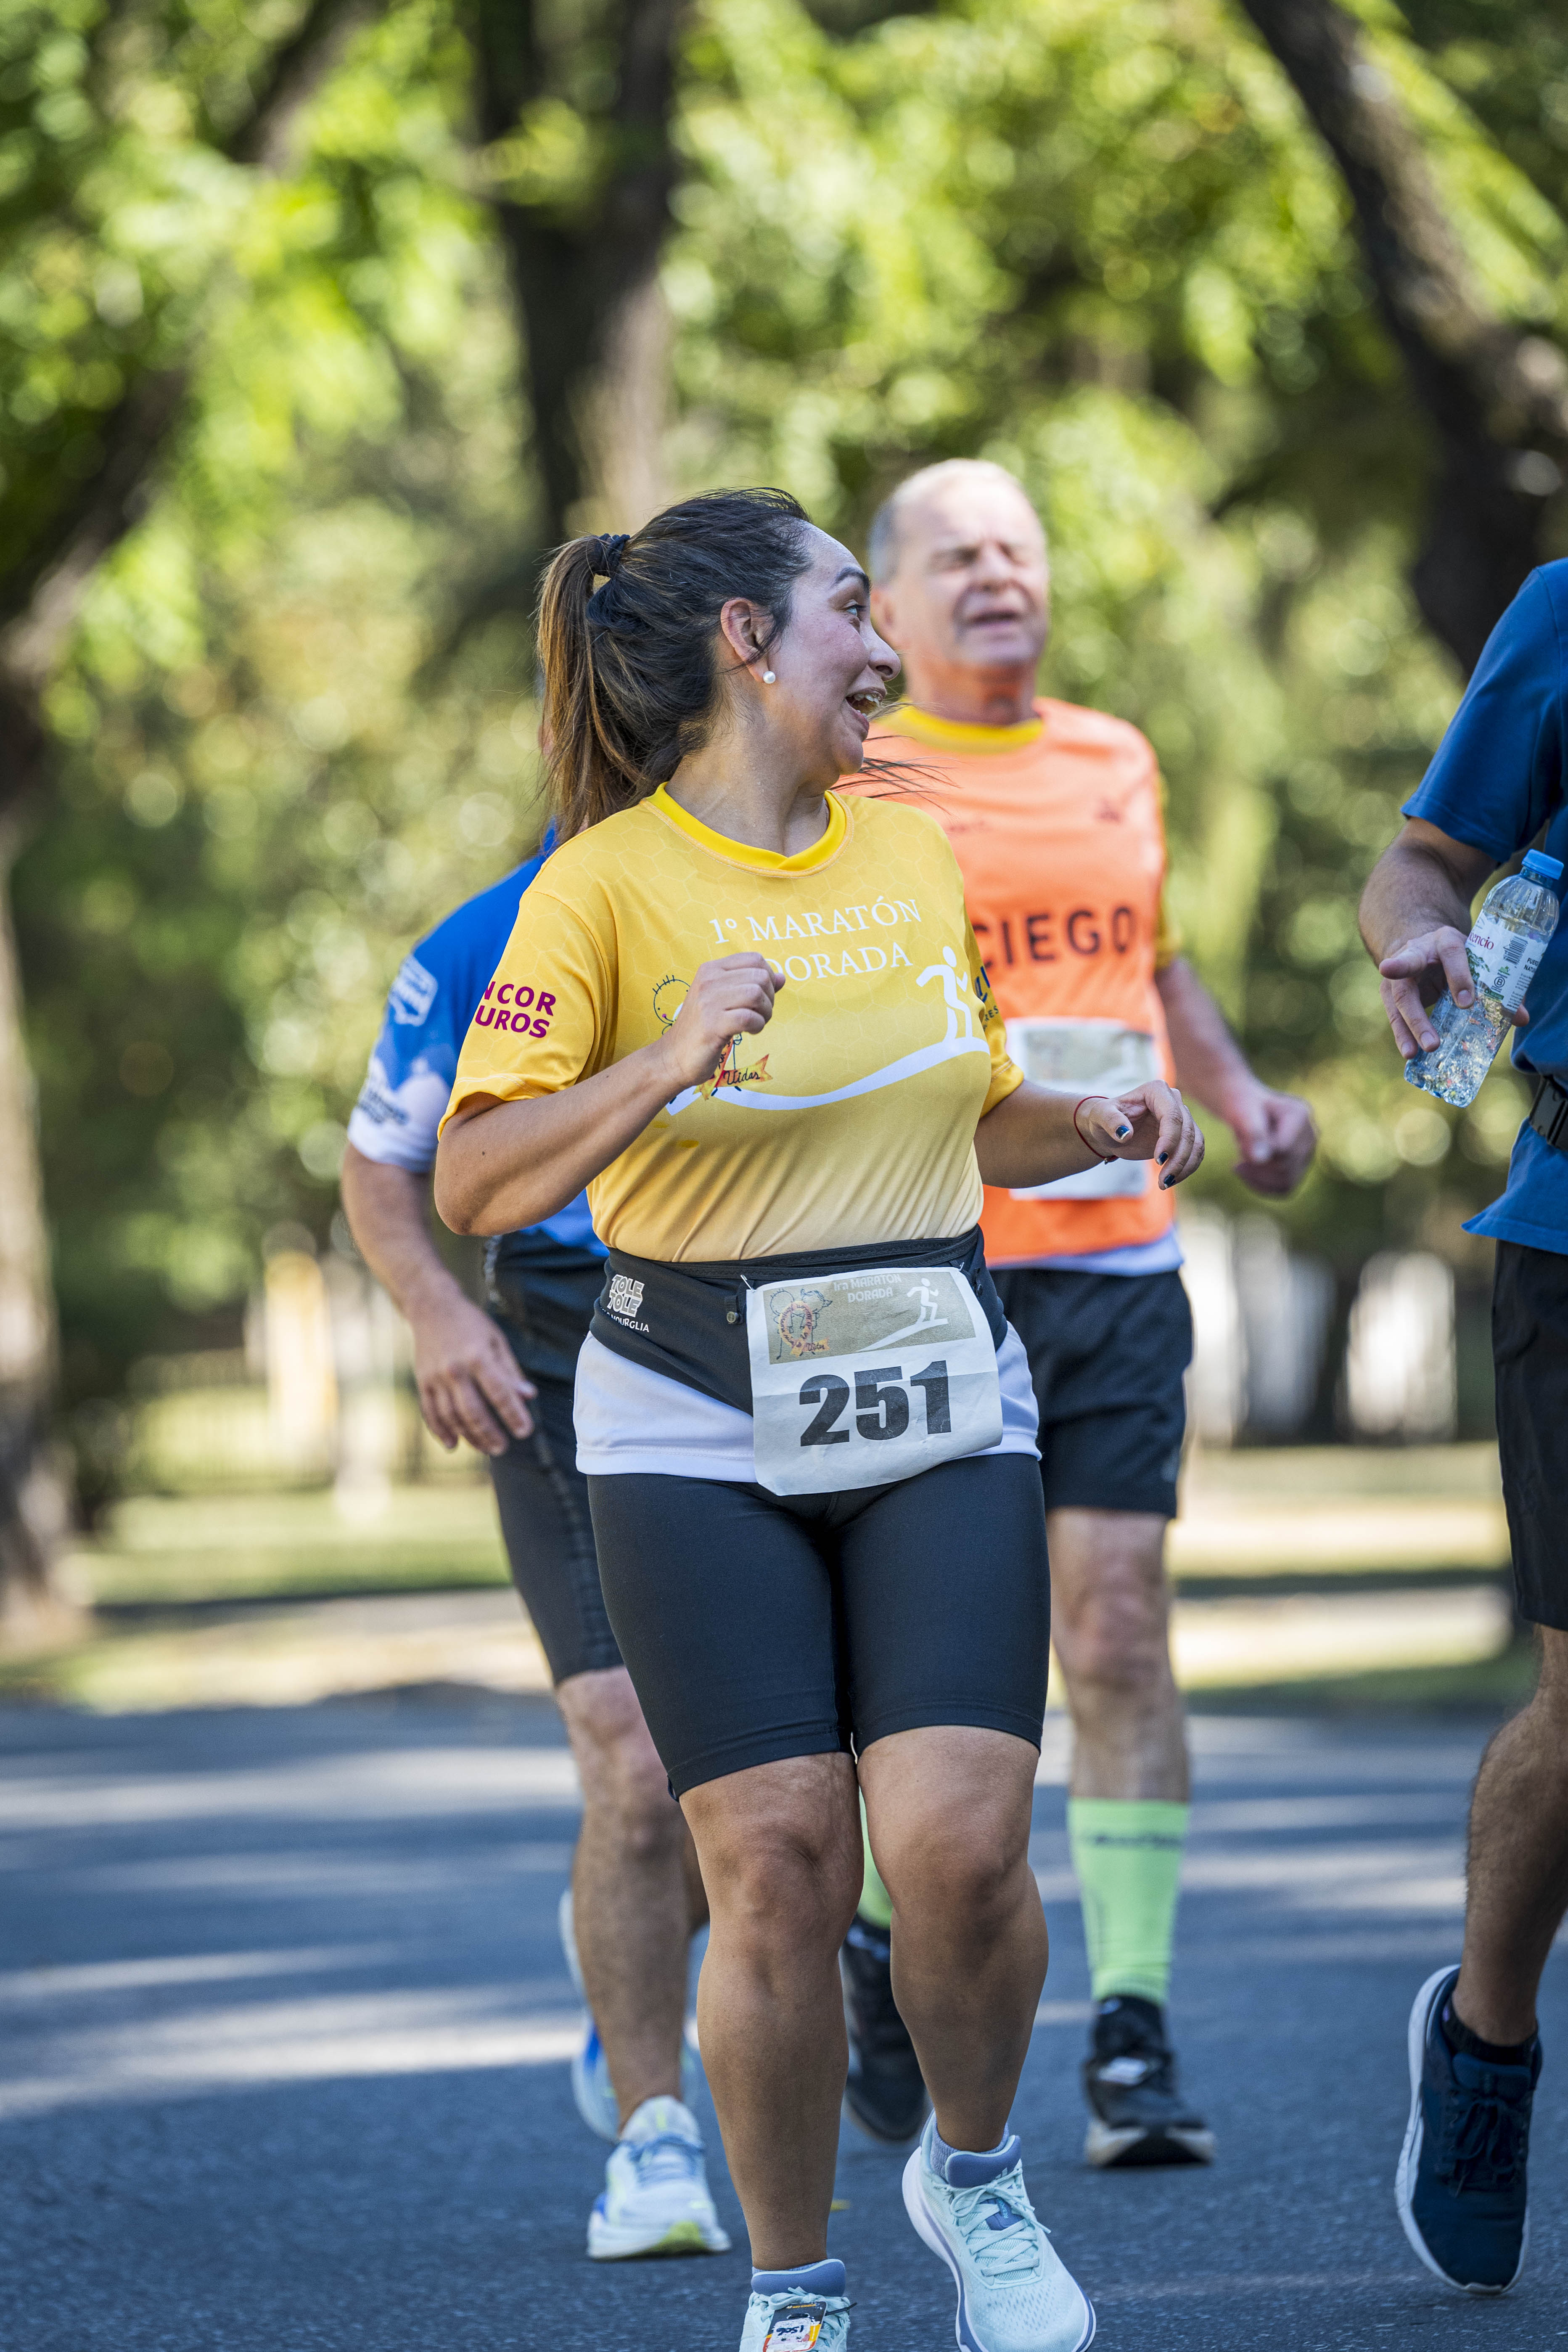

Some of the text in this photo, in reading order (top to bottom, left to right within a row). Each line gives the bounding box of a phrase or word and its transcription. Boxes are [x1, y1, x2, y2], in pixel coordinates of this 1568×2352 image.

[746, 895, 922, 941] MARATÓN
[475, 1005, 550, 1038] UROS
[611, 1274, 645, 1299] TOLE
[847, 1287, 893, 1303] DORADA
[607, 1290, 642, 1318] TOLE
[799, 1360, 952, 1447] 251
